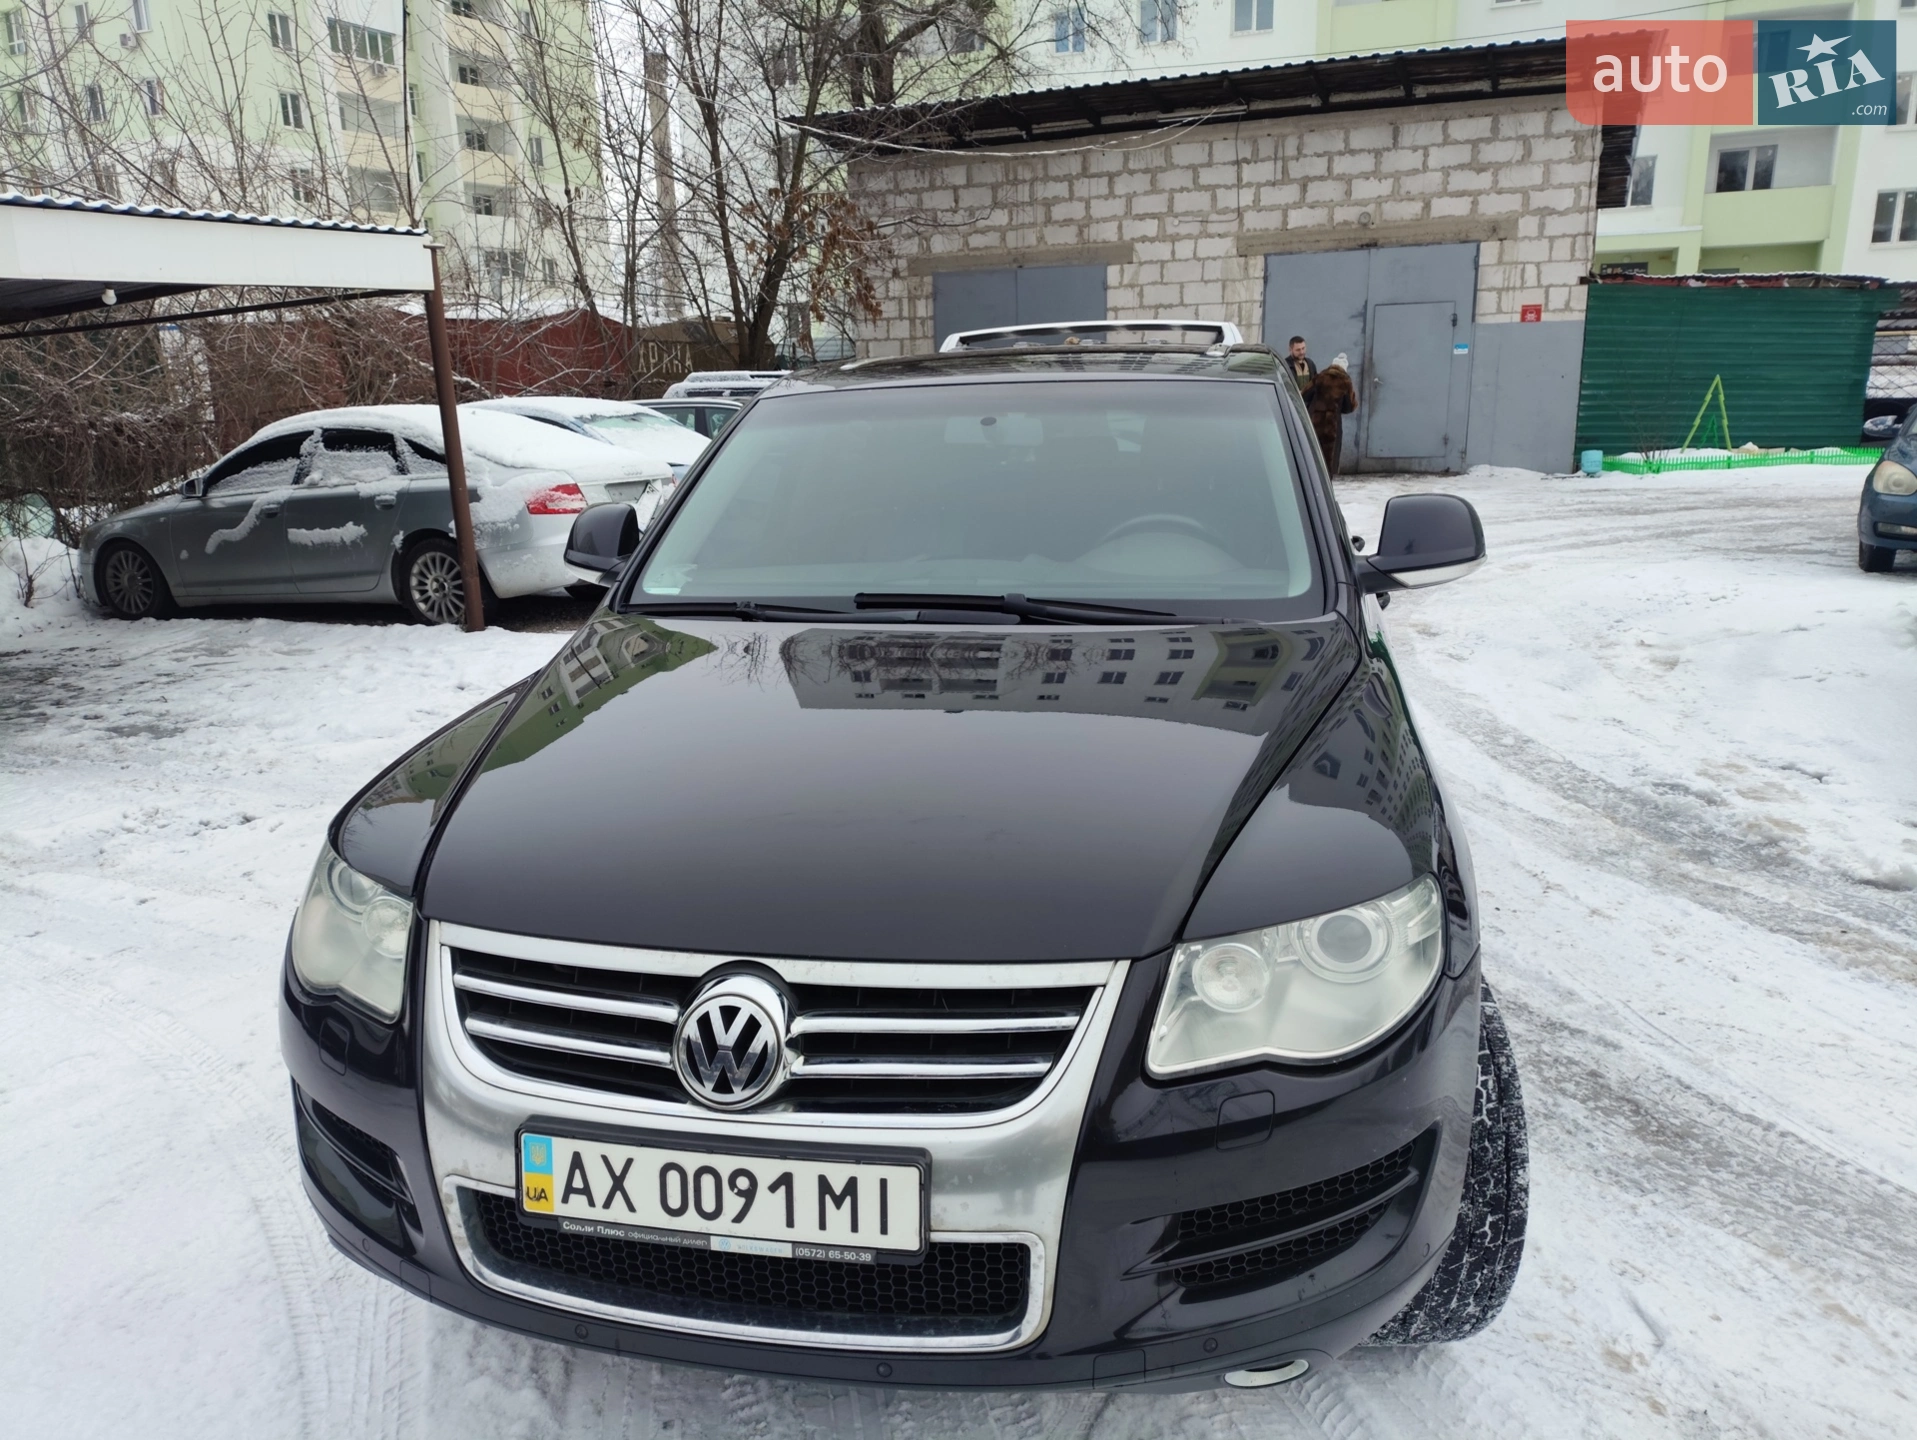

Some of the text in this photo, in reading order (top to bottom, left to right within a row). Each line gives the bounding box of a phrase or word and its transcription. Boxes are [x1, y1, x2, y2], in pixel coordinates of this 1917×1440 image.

[526, 1186, 549, 1202] UA
[561, 1151, 889, 1236] AX 0091 MI
[597, 1225, 625, 1237] Плюс
[795, 1246, 872, 1262] (0572) 65-50-39
